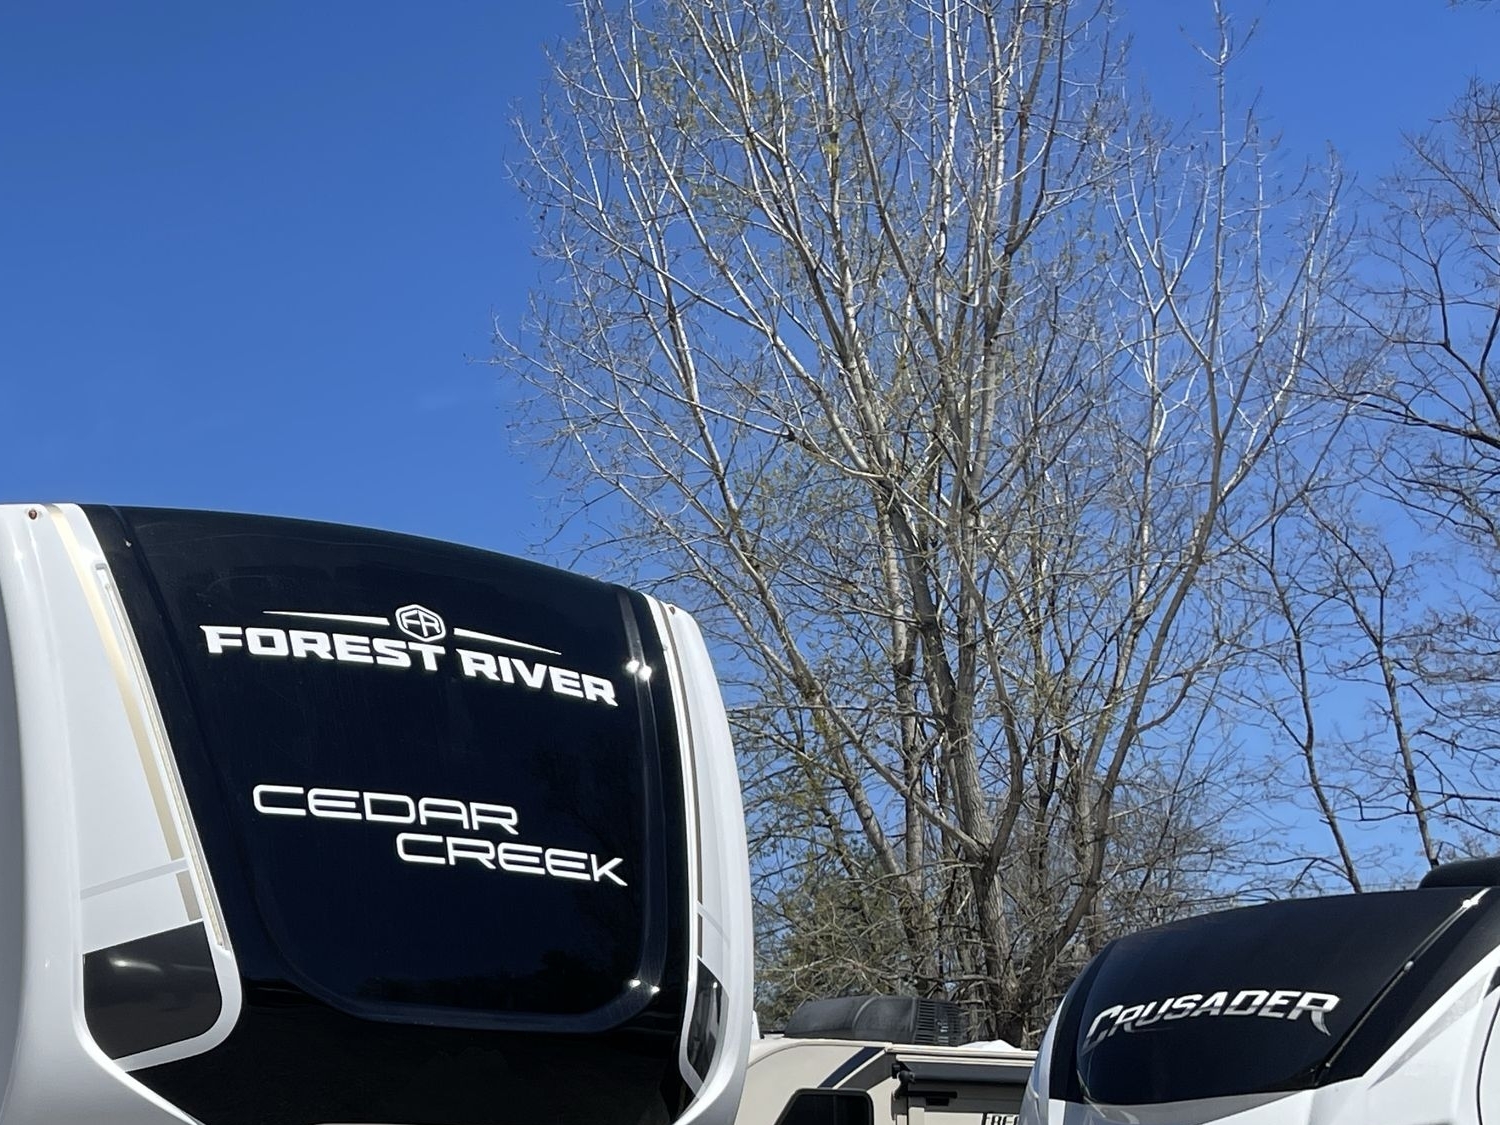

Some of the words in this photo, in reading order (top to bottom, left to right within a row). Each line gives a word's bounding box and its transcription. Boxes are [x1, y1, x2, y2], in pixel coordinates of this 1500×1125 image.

[200, 625, 446, 672] FOREST
[456, 648, 619, 707] RIVER
[252, 783, 519, 835] CEDAR
[395, 832, 628, 887] CREEK
[1079, 989, 1341, 1055] CRUSADER
